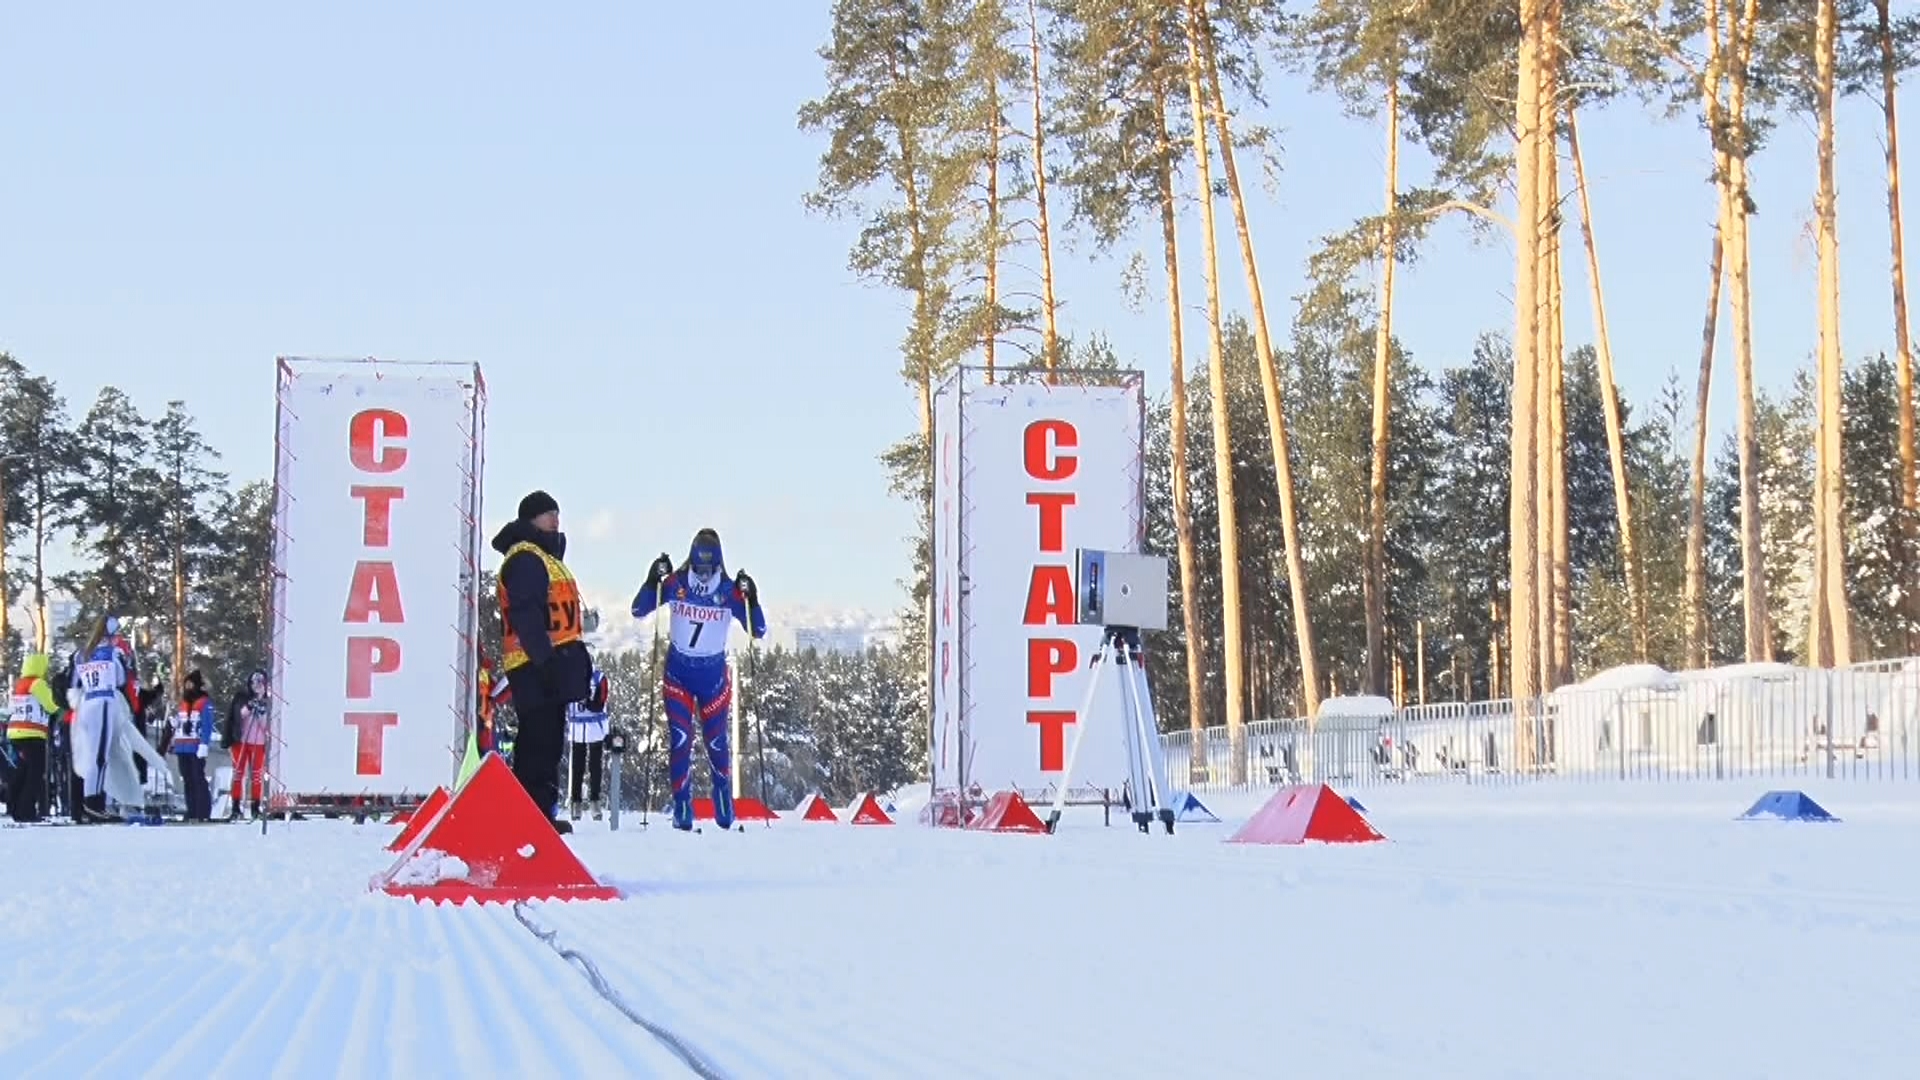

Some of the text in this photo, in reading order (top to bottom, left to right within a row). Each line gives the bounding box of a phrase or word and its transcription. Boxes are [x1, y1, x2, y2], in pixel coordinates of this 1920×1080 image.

[343, 408, 408, 775] СТАРТ
[672, 601, 726, 621] ЗЛАТОУСТ
[688, 620, 704, 648] 7
[1023, 419, 1078, 772] СТАРТ
